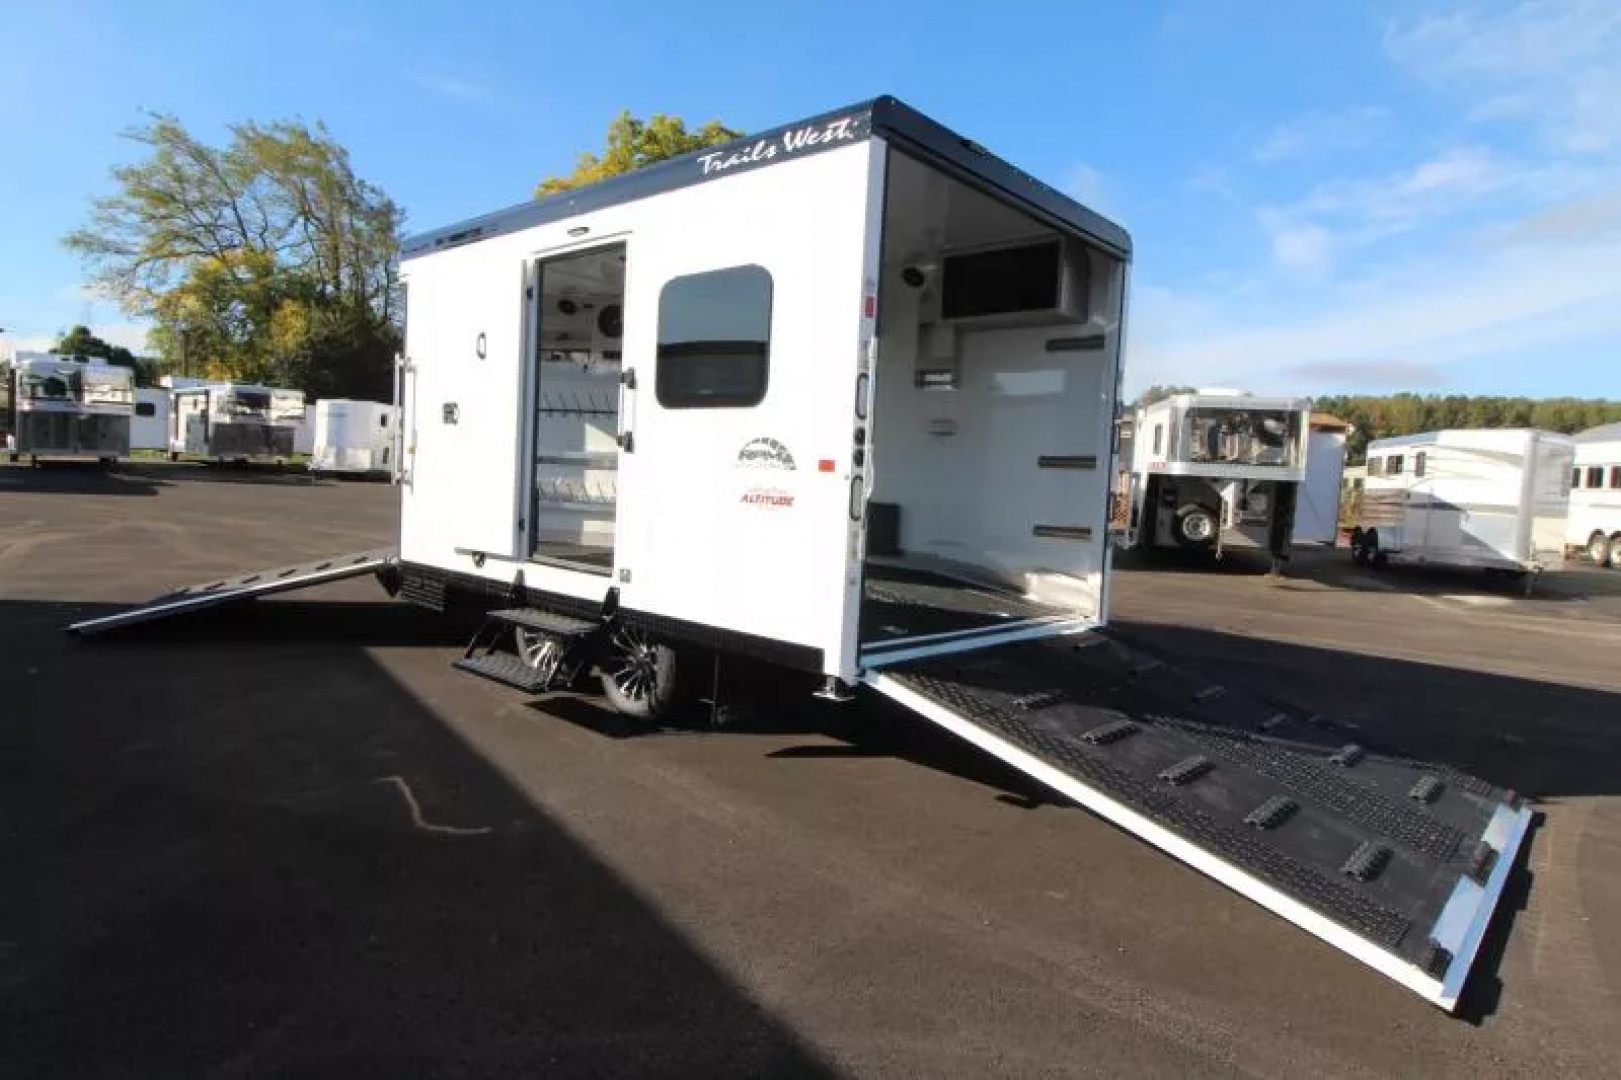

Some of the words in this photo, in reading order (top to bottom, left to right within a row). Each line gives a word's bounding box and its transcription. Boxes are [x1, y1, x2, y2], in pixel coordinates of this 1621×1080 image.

[697, 140, 776, 174] Trails
[784, 117, 853, 151] West
[740, 494, 795, 507] ALTITUDE
